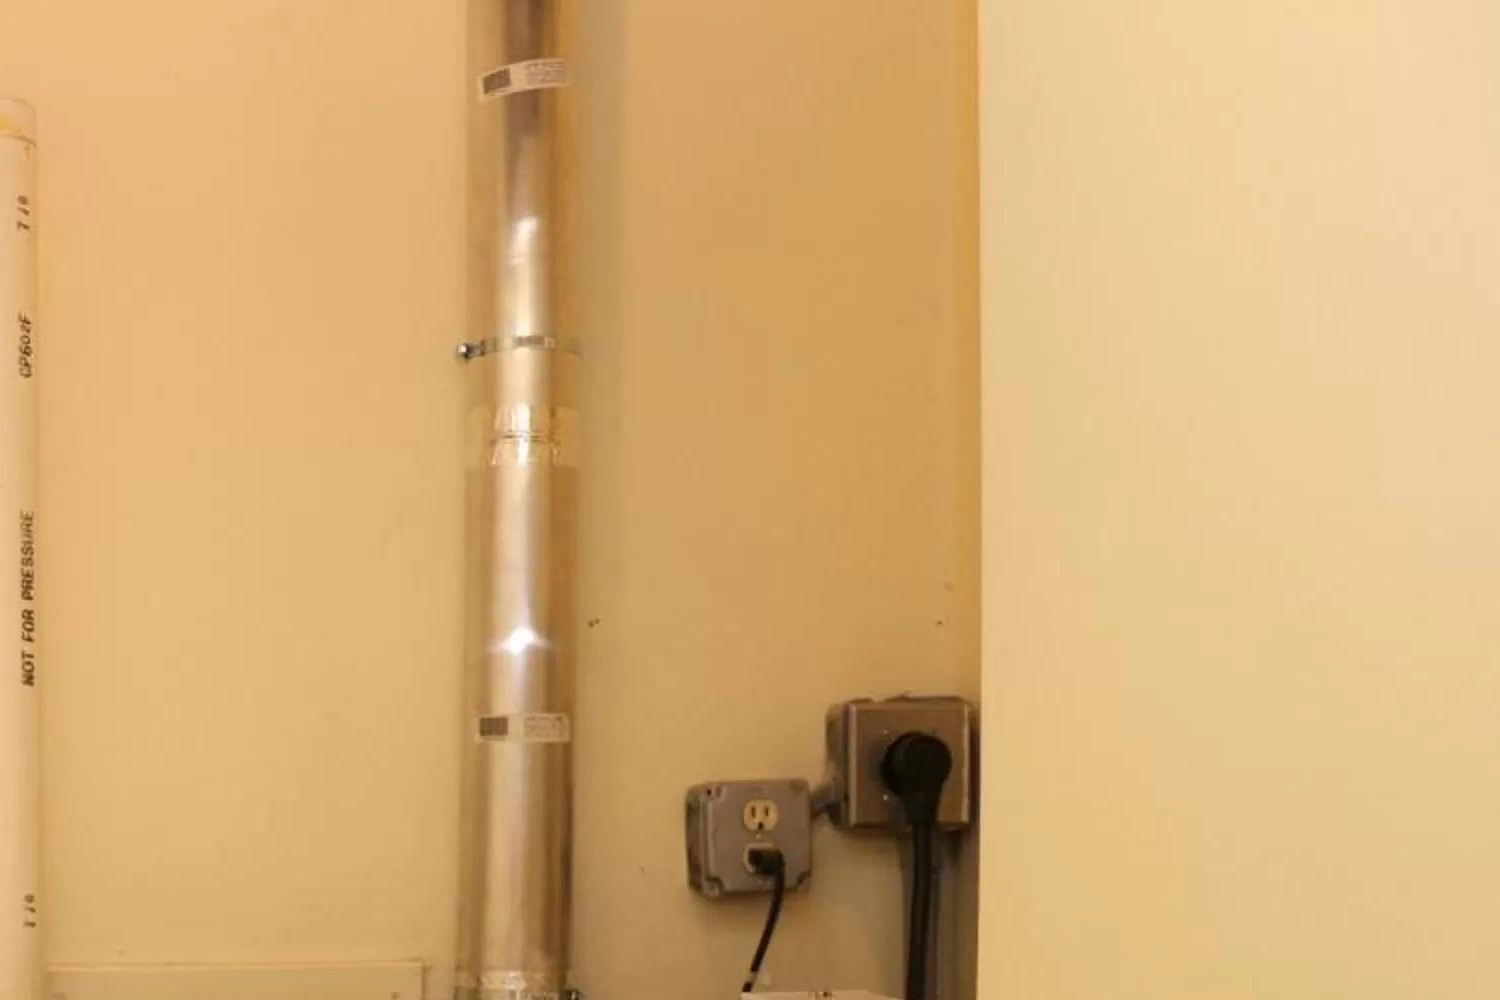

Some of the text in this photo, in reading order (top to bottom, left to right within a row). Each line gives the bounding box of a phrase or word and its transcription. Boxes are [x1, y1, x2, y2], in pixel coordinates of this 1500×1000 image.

[19, 508, 36, 687] NOT FOR PRESSURE
